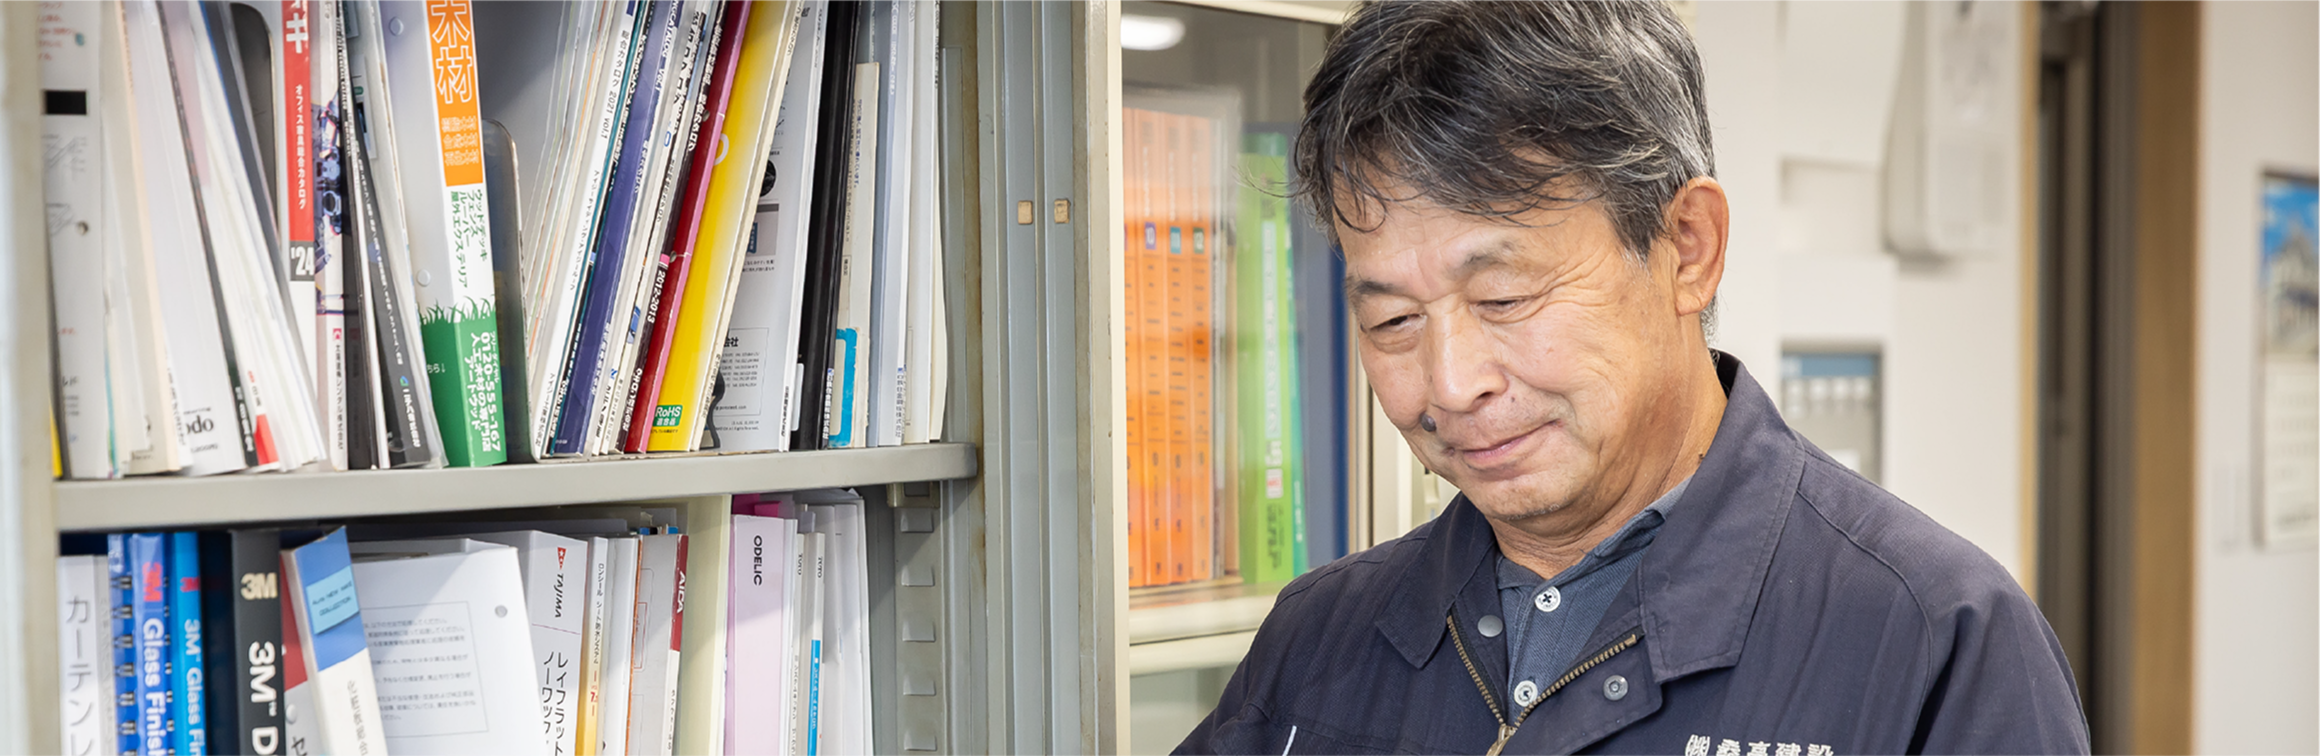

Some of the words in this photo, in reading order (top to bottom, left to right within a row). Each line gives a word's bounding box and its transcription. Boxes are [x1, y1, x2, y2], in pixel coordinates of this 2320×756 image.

[612, 30, 630, 88] 総合カタログ
[600, 117, 611, 139] vol.1
[605, 90, 617, 116] 2021
[459, 191, 471, 247] ルーバー
[467, 189, 479, 238] フェンス
[290, 246, 314, 276] '24
[450, 190, 468, 289] 屋外エクステリア
[647, 270, 668, 323] 2012-2013
[464, 355, 482, 431] アートウッド
[470, 332, 493, 453] 人工木材の専門店
[480, 331, 502, 453] 0120-555-167
[655, 406, 682, 418] RoHS
[142, 562, 163, 602] 3M
[240, 572, 278, 600] 3M
[753, 535, 763, 586] ODELIC
[553, 573, 564, 618] TAJIMA
[676, 570, 687, 614] AICA
[142, 617, 165, 687] Glass
[186, 667, 203, 725] Glass
